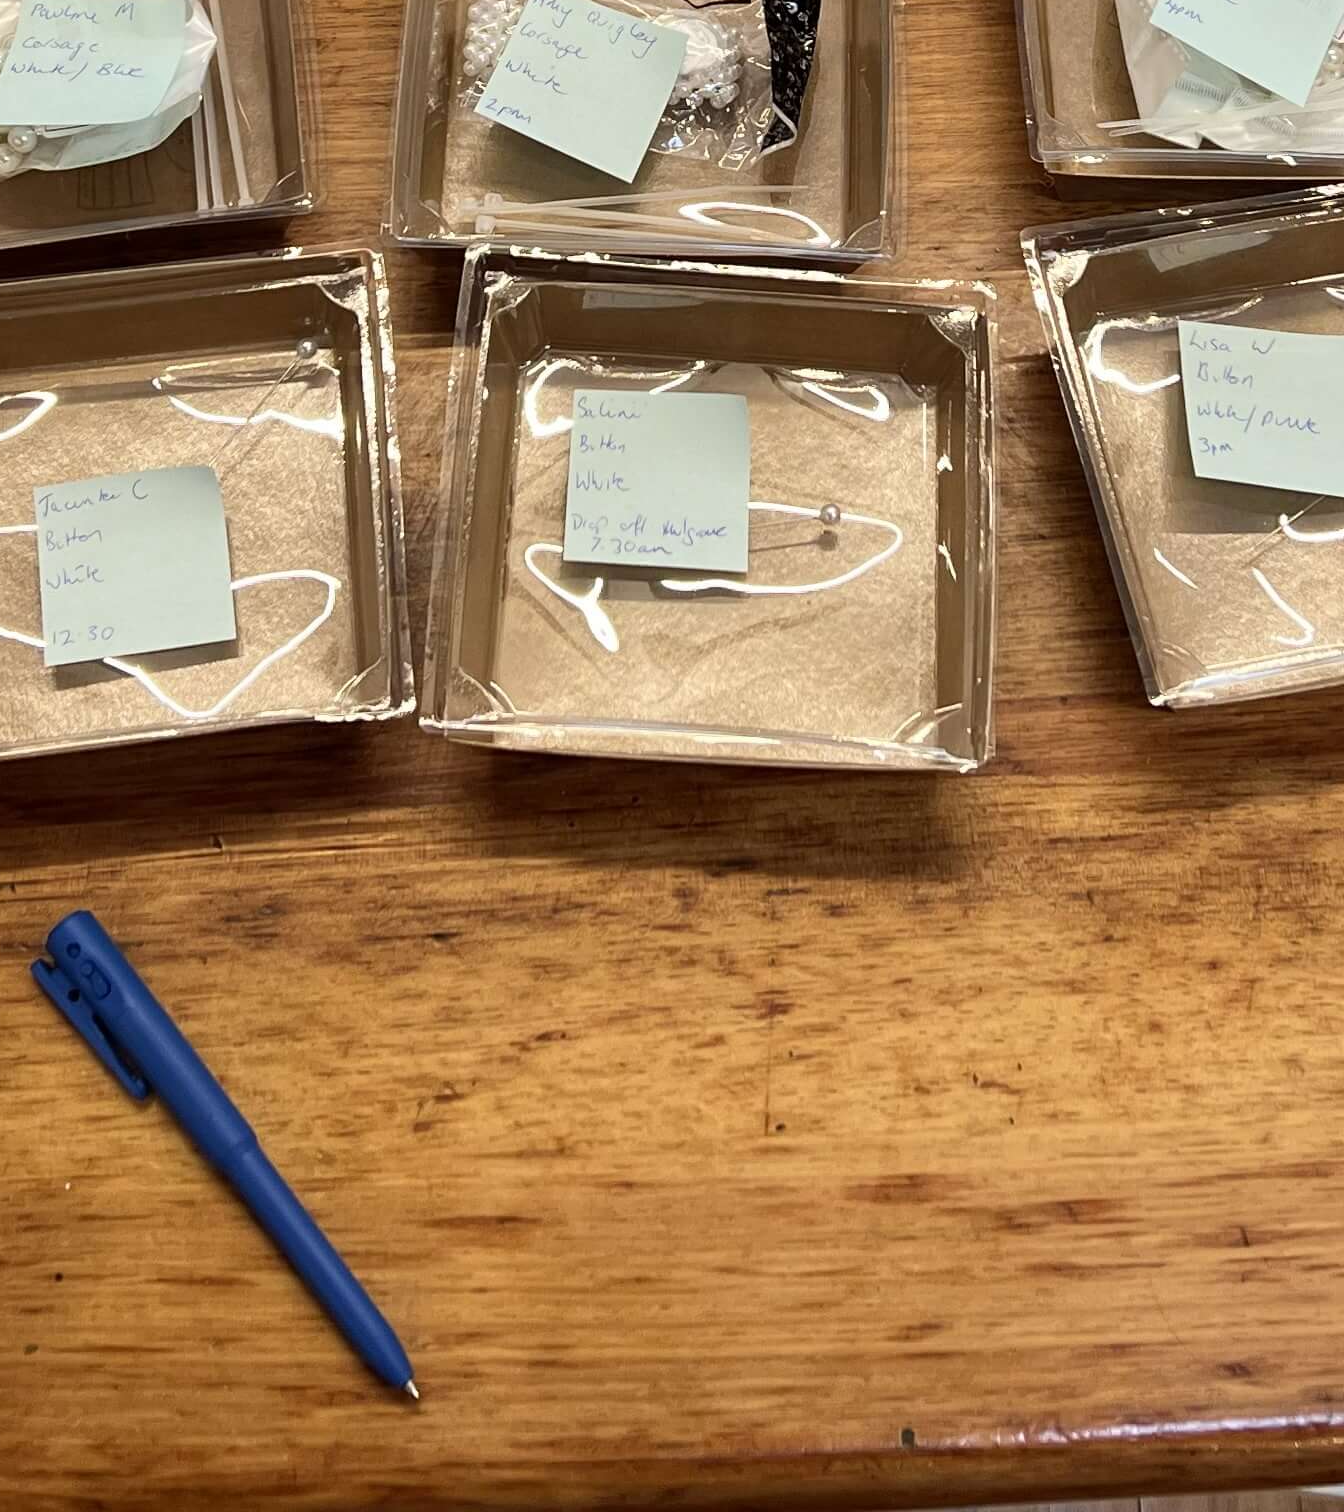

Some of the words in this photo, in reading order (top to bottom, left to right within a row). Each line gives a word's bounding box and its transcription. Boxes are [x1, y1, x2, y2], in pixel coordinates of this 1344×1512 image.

[114, 3, 135, 20] M
[132, 479, 148, 500] C
[46, 528, 102, 552] Button
